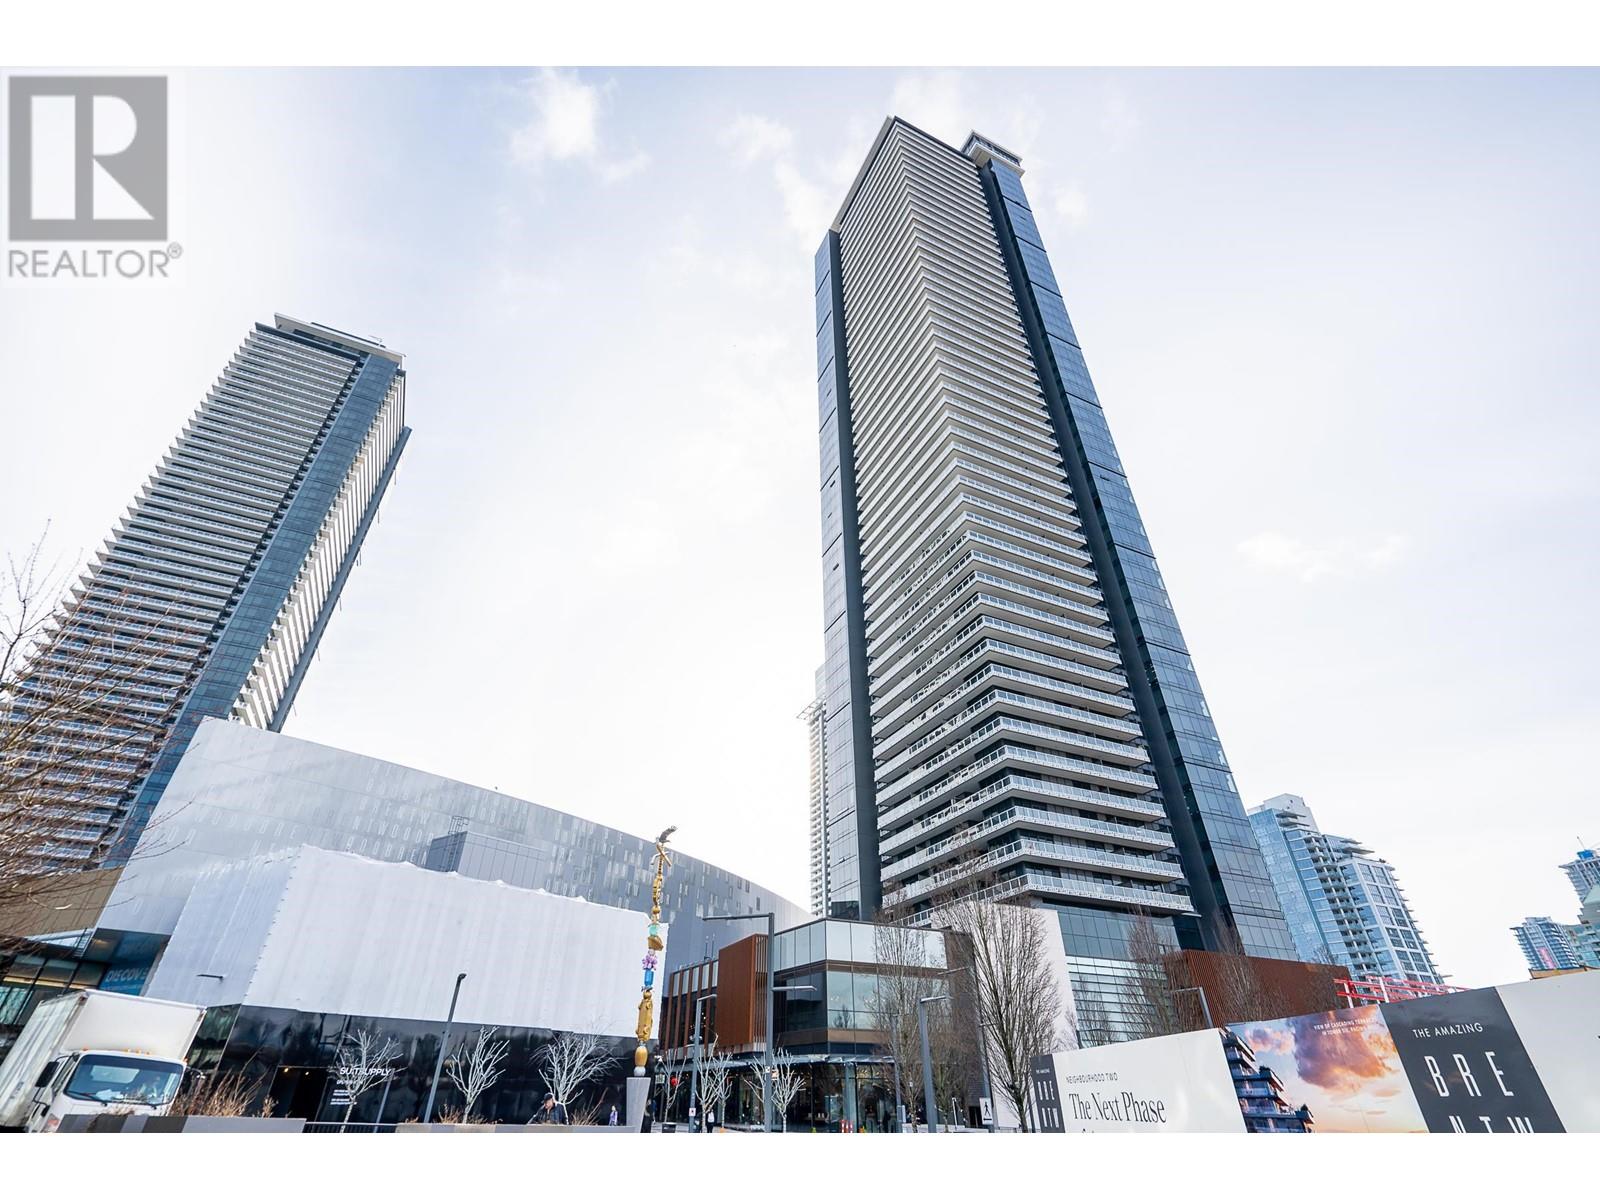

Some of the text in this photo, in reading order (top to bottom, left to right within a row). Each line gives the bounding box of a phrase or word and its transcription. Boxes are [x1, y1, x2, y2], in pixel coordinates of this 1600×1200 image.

[1412, 1022, 1484, 1039] THE AMAZING
[1065, 1071, 1119, 1085] NEIGHBOURHOOD TWO
[1424, 1051, 1514, 1097] BRE
[1068, 1091, 1167, 1124] The Next Phase
